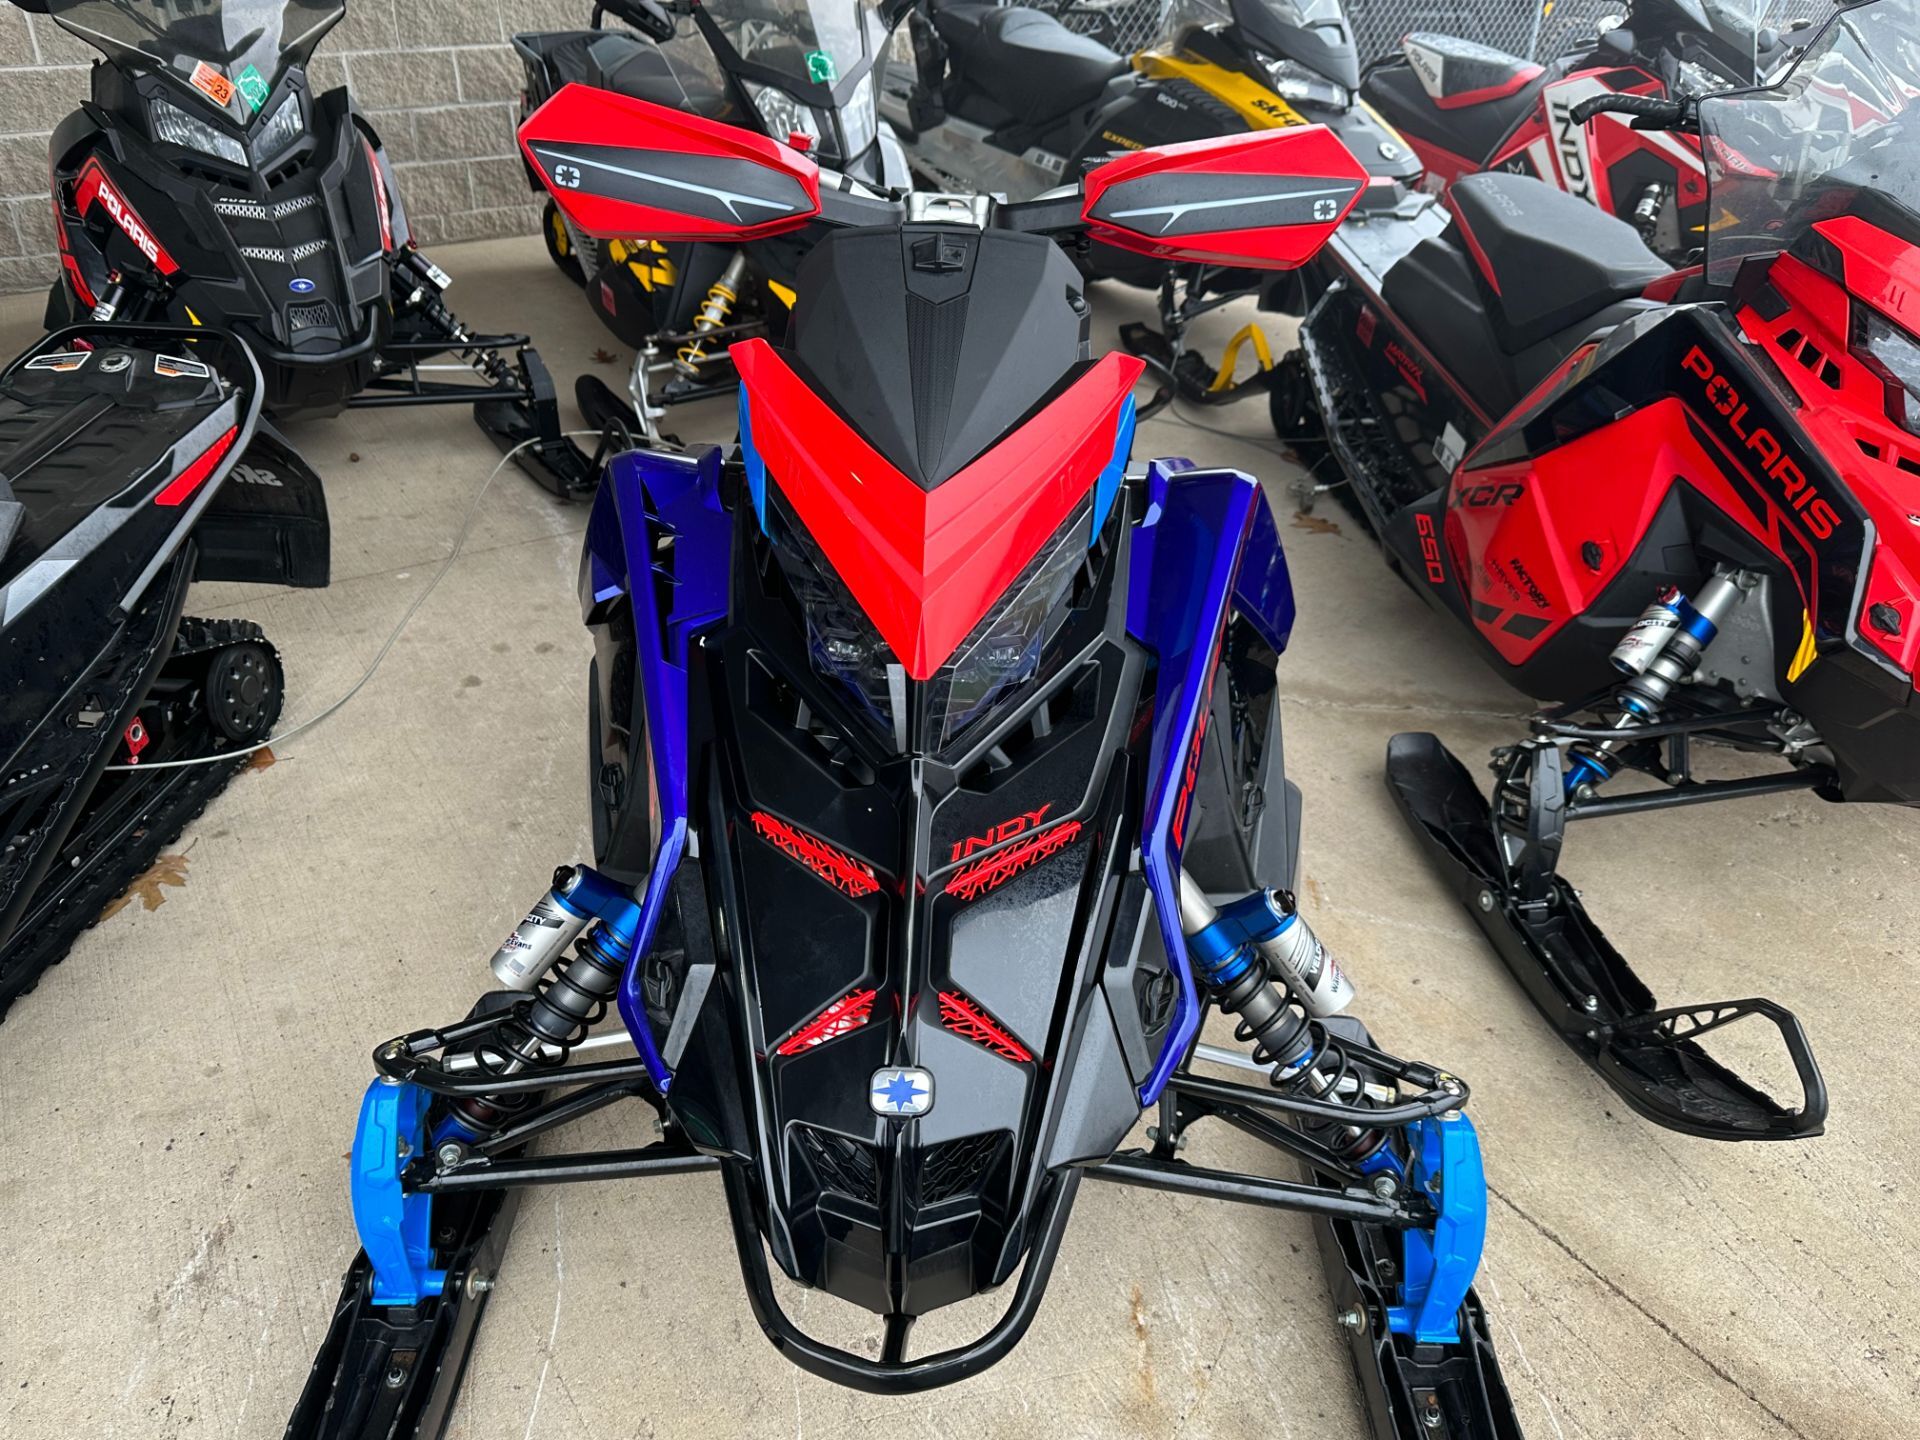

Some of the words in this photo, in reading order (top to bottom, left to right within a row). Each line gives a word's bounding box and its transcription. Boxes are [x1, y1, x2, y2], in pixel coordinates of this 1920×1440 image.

[213, 85, 229, 99] 23
[1552, 100, 1597, 206] INDY
[98, 181, 158, 263] POLARIS
[1681, 344, 1842, 540] POLARIS
[1451, 484, 1525, 508] XCR
[1415, 513, 1446, 583] 650
[951, 802, 1051, 862] INDY
